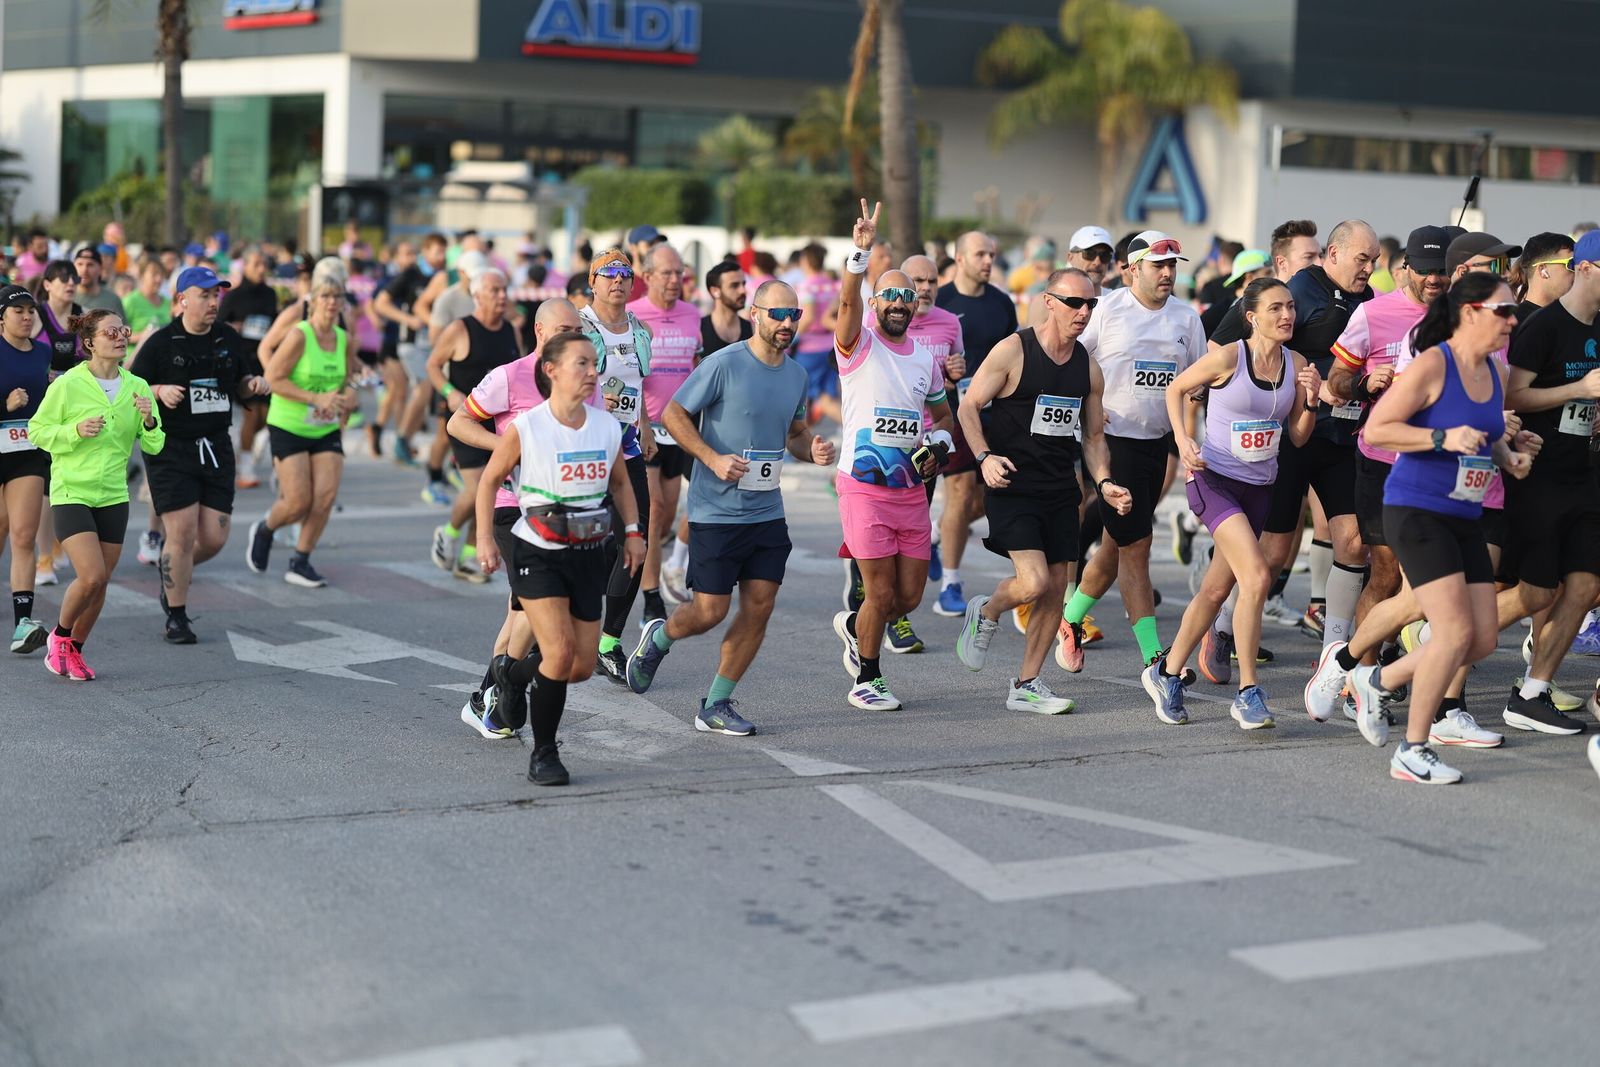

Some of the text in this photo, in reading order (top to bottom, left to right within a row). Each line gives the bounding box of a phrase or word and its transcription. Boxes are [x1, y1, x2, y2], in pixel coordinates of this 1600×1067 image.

[524, 0, 702, 53] ALDI
[1134, 370, 1174, 387] 2026
[1042, 406, 1073, 424] 596
[874, 417, 919, 437] 2244
[1240, 430, 1275, 449] 887
[560, 461, 608, 482] 2435
[760, 462, 772, 478] 6
